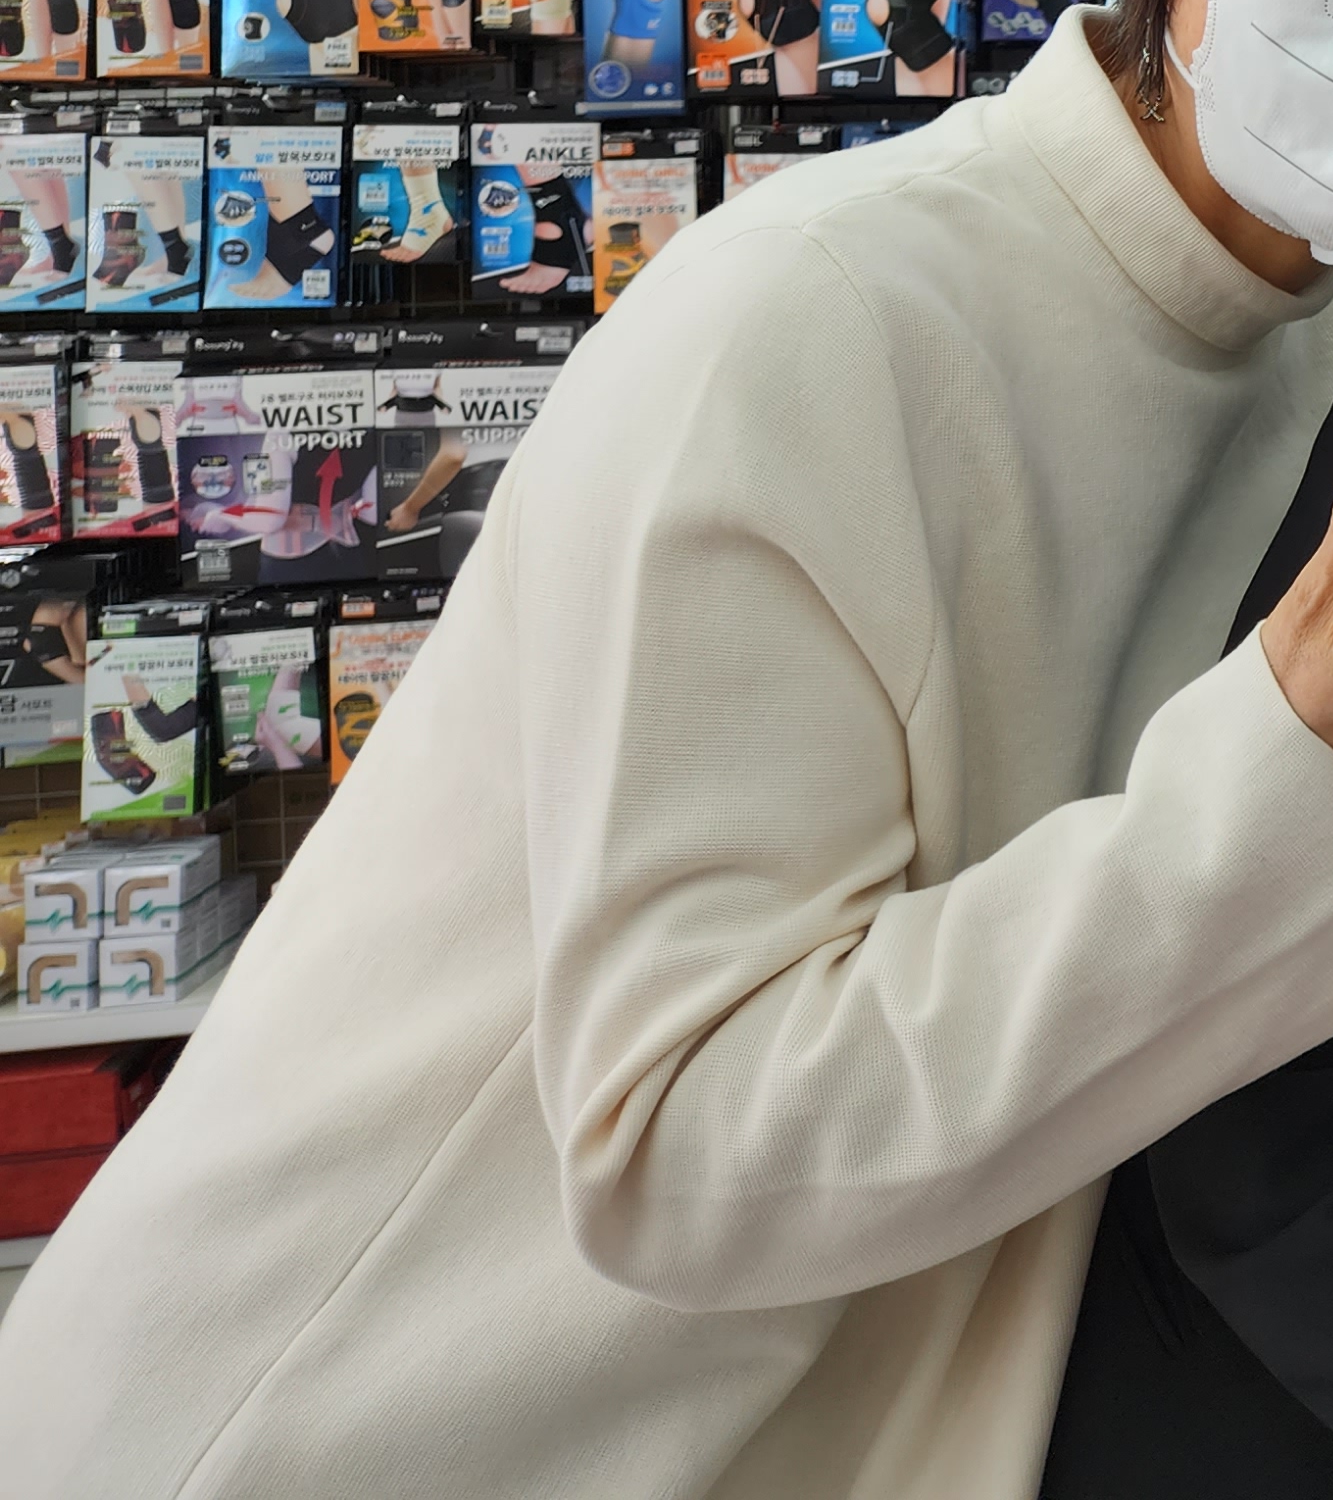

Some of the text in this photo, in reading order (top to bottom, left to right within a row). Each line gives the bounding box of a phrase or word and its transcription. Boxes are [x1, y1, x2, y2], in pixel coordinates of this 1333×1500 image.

[525, 147, 593, 161] ANKLE
[261, 404, 365, 428] WAIST
[460, 400, 547, 421] WAIS
[265, 430, 368, 451] SUPPORT
